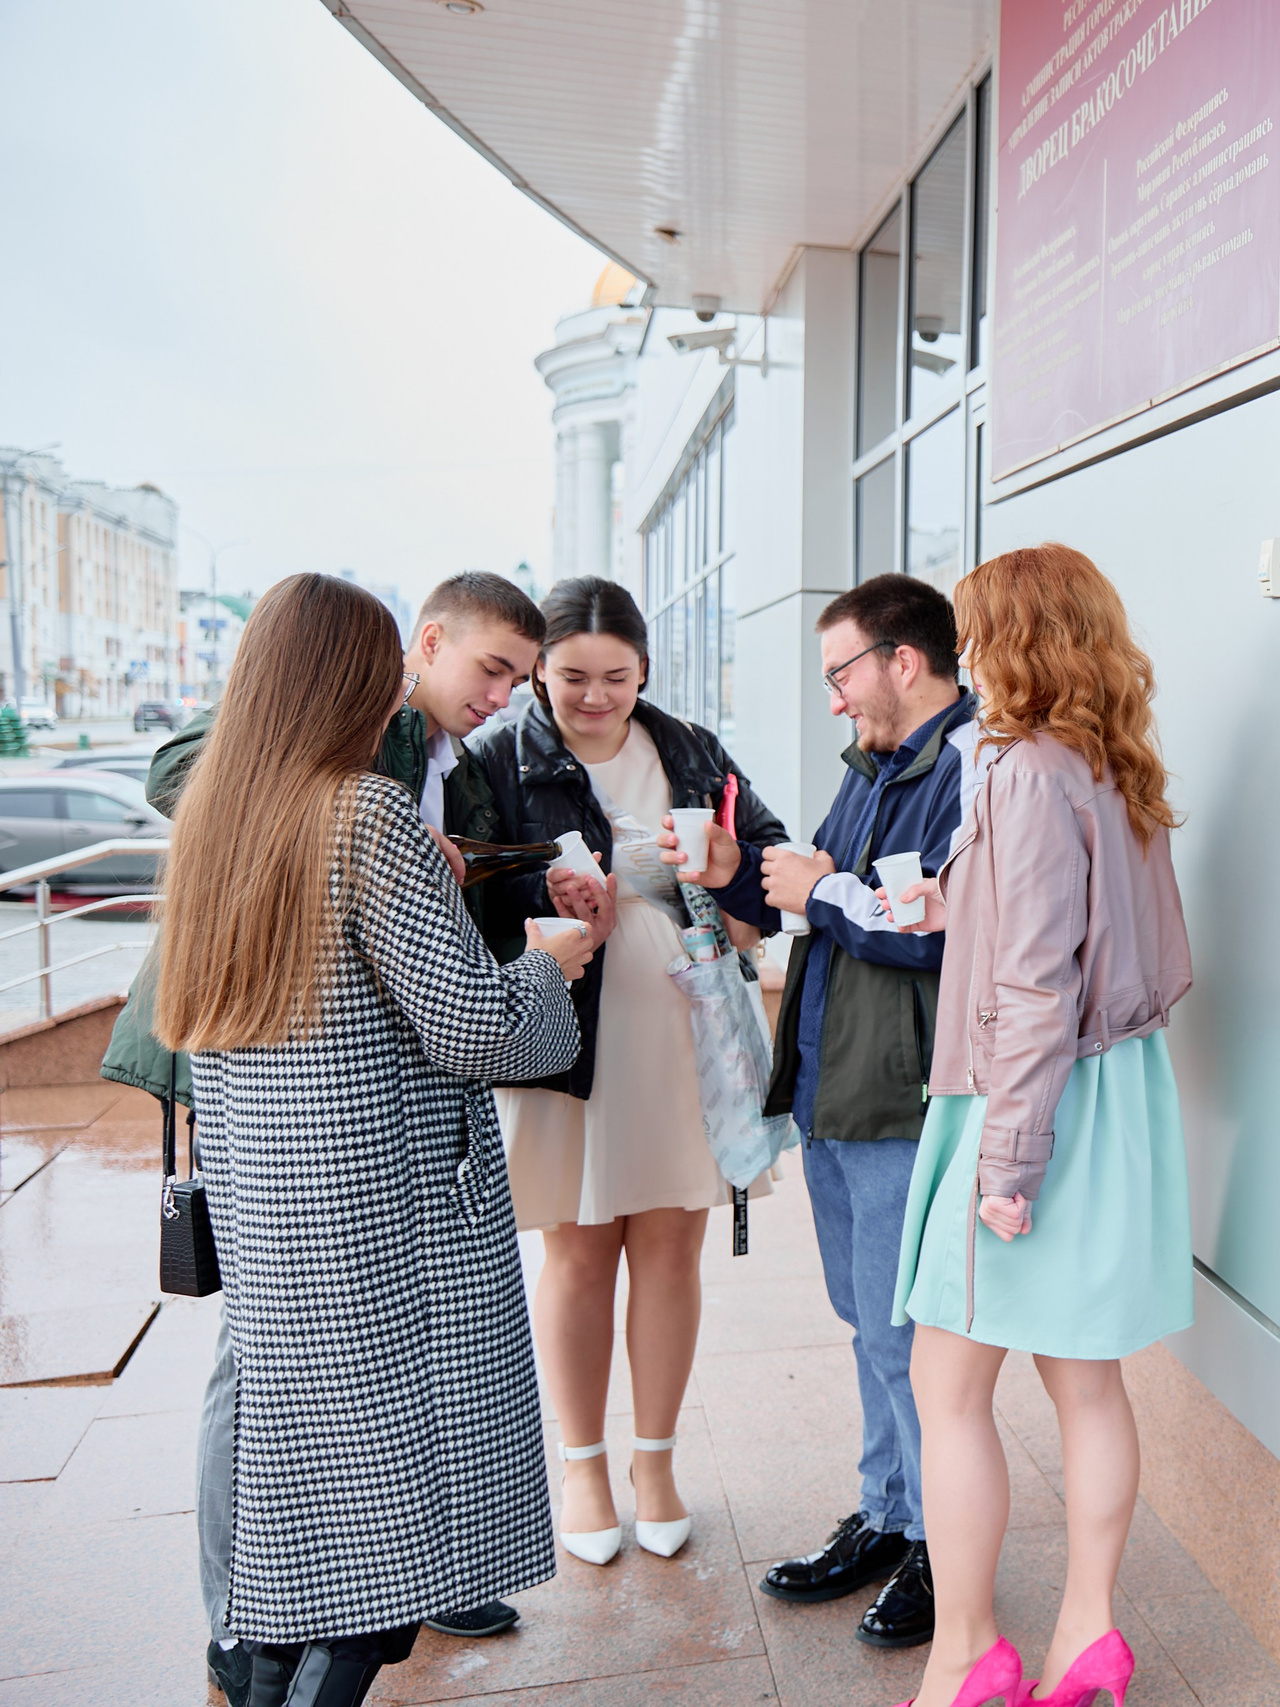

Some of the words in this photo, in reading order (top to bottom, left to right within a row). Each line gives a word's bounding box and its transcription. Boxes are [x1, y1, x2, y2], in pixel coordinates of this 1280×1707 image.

[1021, 22, 1085, 108] АДМИНИСТРАЦИЯ
[1086, 0, 1115, 37] ГОРОД
[1050, 58, 1081, 107] ЗАПИСИ
[1081, 26, 1109, 73] АКТОВ
[1108, 0, 1143, 41] ГРАЖД
[1063, 0, 1087, 32] РЕСП
[1017, 120, 1069, 202] ДВОРЕЦ
[1136, 132, 1175, 178] Российской
[1175, 87, 1229, 142] Федерациясь
[1160, 176, 1191, 211] Саранск
[1192, 116, 1273, 187] администрациясь
[1171, 120, 1226, 175] Республикась
[1208, 152, 1269, 205] сёрмадомань
